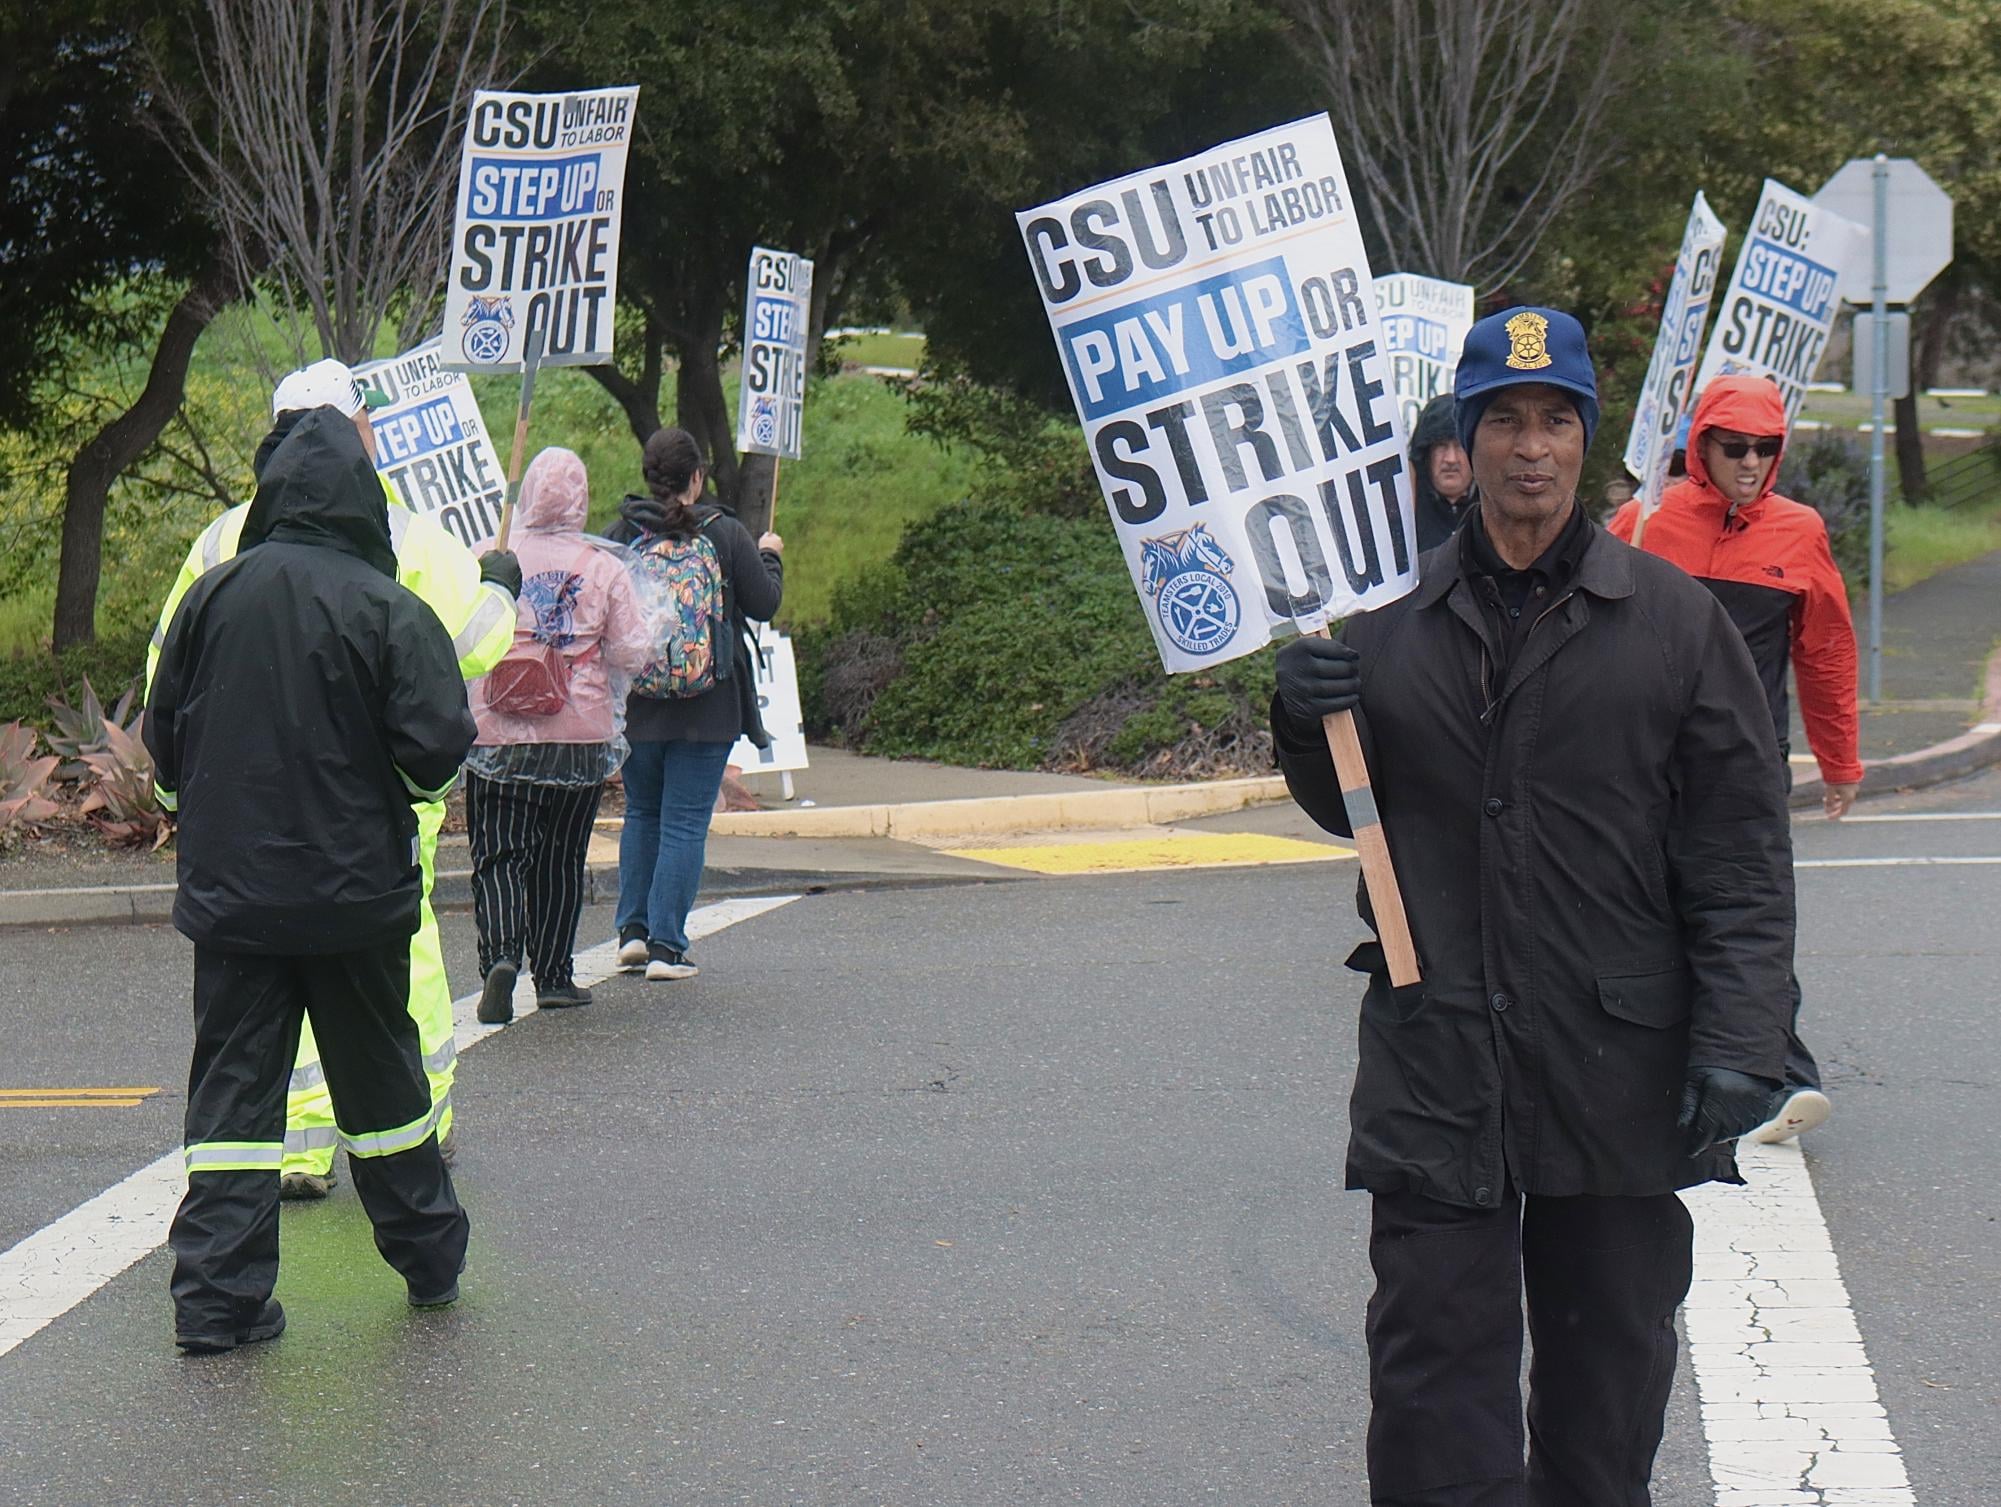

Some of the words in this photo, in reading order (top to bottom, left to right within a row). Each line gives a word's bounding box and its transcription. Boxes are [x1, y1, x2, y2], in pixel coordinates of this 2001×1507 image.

[473, 100, 560, 149] CSU
[560, 132, 577, 148] TO
[578, 126, 625, 145] LABOR
[473, 165, 560, 216] STEP
[560, 161, 597, 212] UP
[597, 190, 614, 211] OR
[1184, 142, 1304, 209] UNFAIR
[1026, 179, 1188, 304] CSU
[1196, 211, 1243, 251] TO
[1249, 175, 1345, 237] LABOR
[460, 217, 610, 291] STRIKE
[1743, 245, 1808, 302] STEP
[1800, 269, 1833, 314] UP
[523, 286, 607, 363] OUT
[1069, 302, 1189, 404] PAY
[1198, 272, 1291, 360] UP
[1301, 266, 1368, 339] OR
[1417, 321, 1446, 357] UP
[1723, 296, 1825, 385] STRIKE
[400, 351, 441, 386] UNFA
[404, 384, 421, 399] TO
[423, 372, 461, 394] LABOR
[374, 414, 422, 464] TEP
[421, 403, 456, 446] UP
[462, 419, 479, 437] OR
[1094, 339, 1395, 525] STRIKE
[388, 440, 497, 514] TRIKE
[1244, 454, 1411, 618] OUT
[1162, 575, 1188, 618] TEAMSTERS
[1190, 573, 1216, 586] LOCAL
[1215, 582, 1232, 600] 2010
[1177, 635, 1208, 651] SKILLED
[1210, 621, 1233, 648] TRADES
